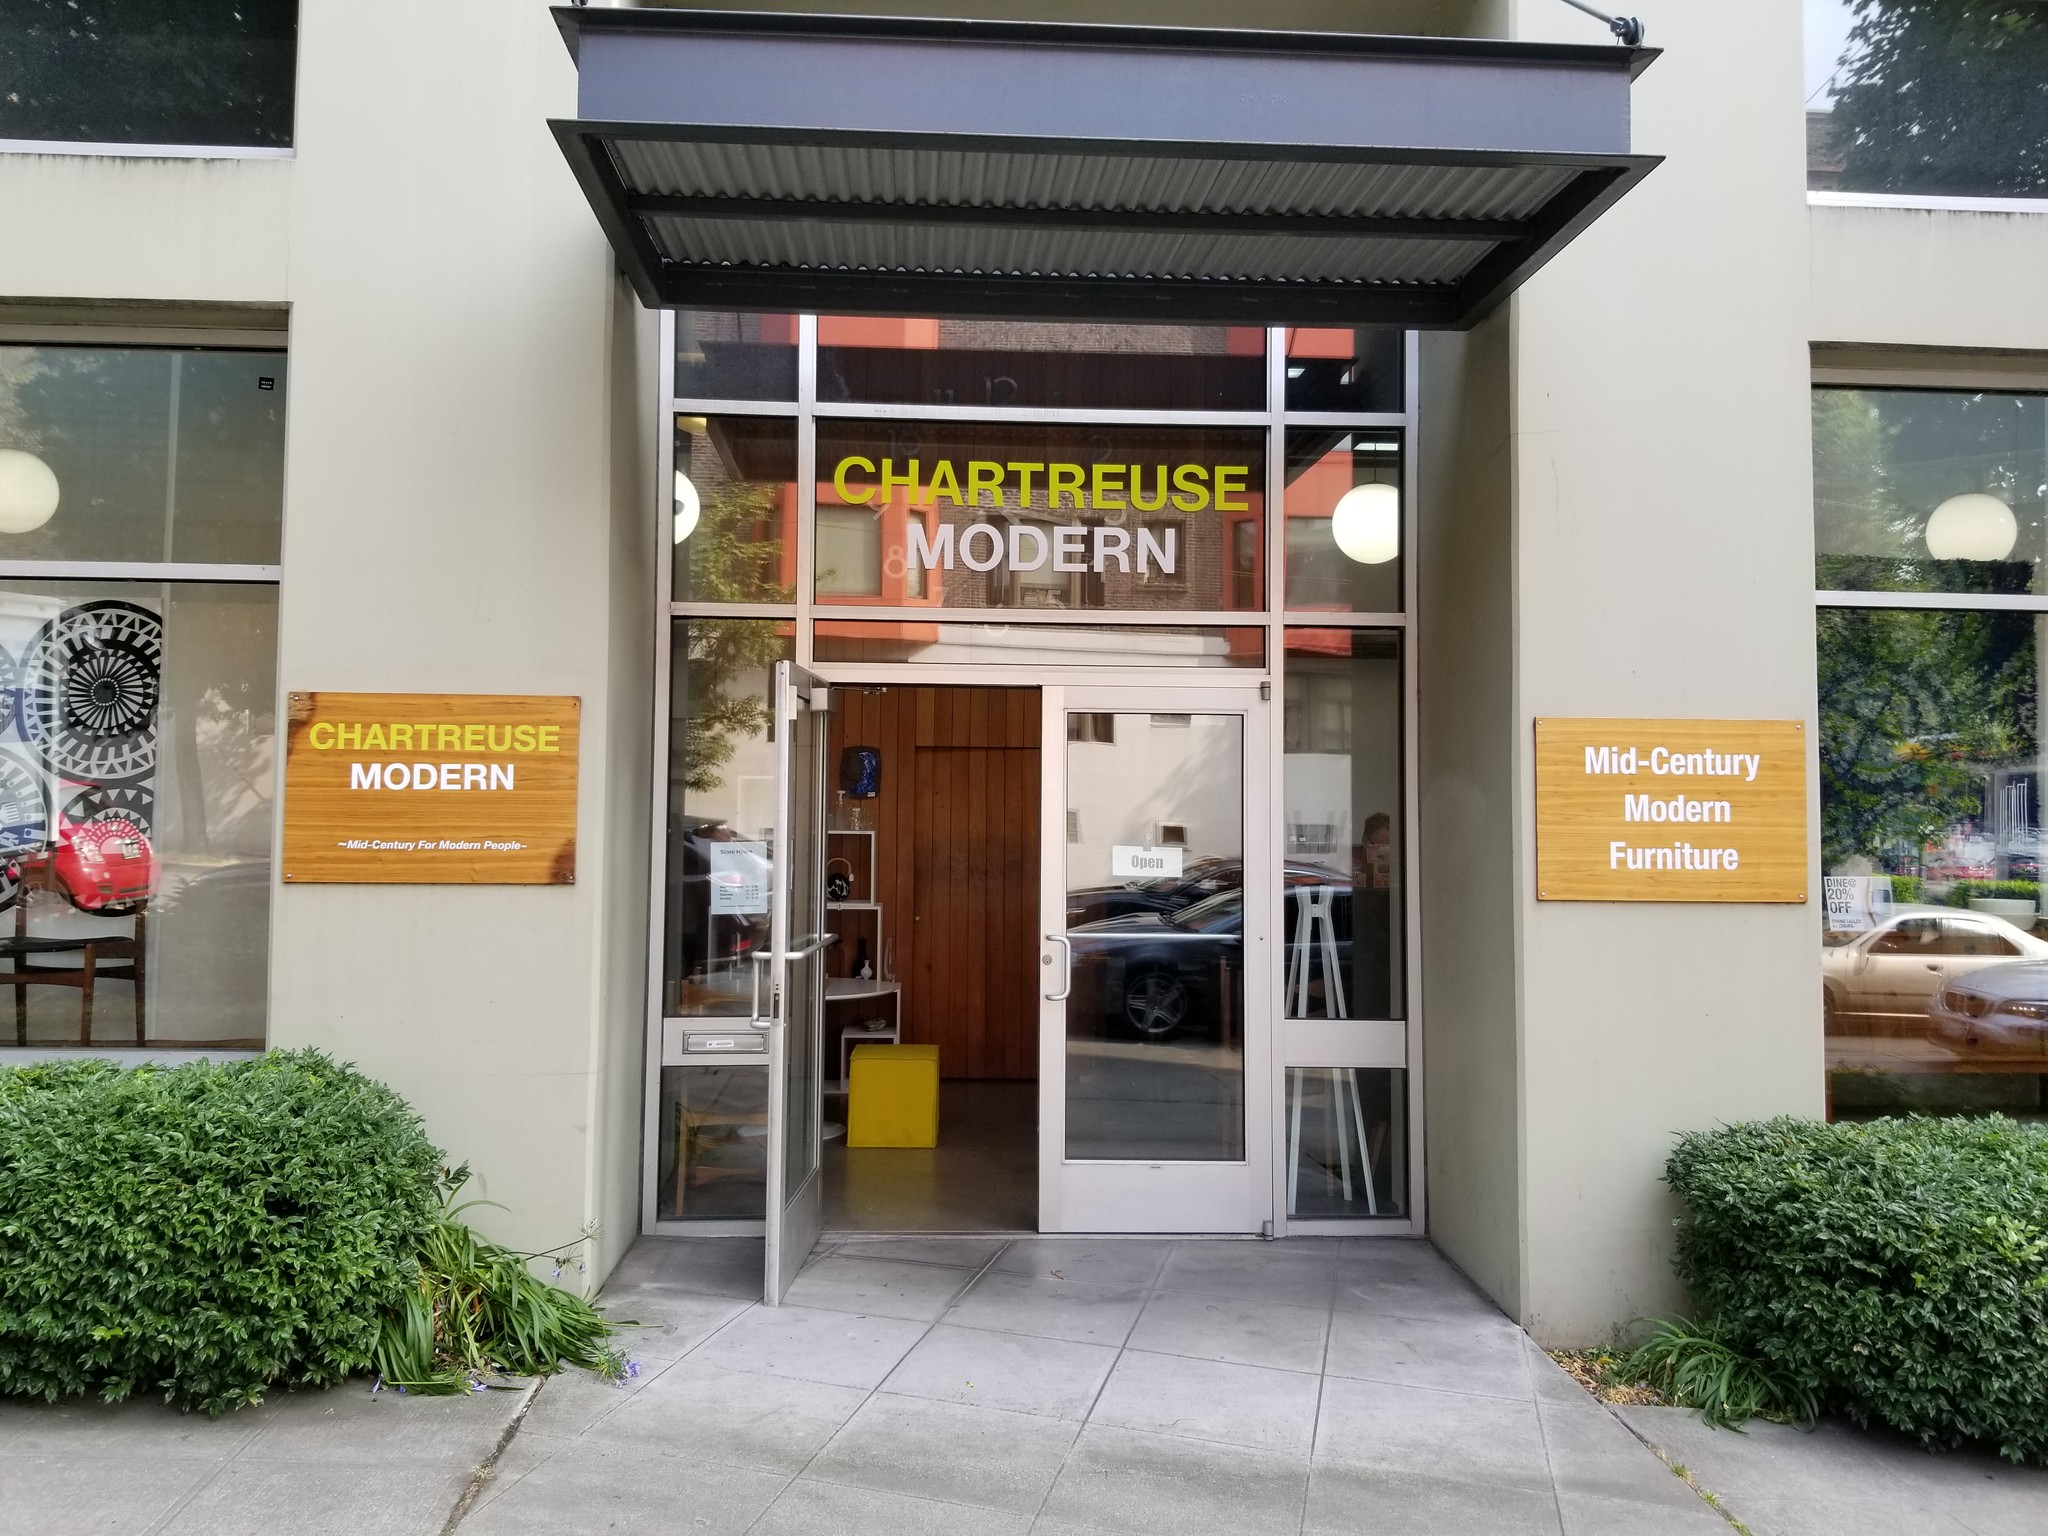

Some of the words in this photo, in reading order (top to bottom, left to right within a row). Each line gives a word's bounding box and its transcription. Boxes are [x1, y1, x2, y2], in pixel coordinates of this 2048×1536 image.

[833, 456, 1249, 512] CHARTREUSE
[907, 523, 1176, 575] MODERN
[309, 722, 560, 752] CHARTREUSE
[350, 762, 514, 790] MODERN
[1585, 746, 1760, 782] Mid-Century
[1624, 794, 1731, 822] Modern
[417, 840, 438, 850] For
[439, 840, 481, 850] Modern
[1610, 841, 1738, 870] Furniture
[1131, 855, 1163, 869] Open
[1826, 878, 1857, 888] DINE@
[1827, 888, 1855, 900] 20%
[1829, 901, 1852, 914] OFF
